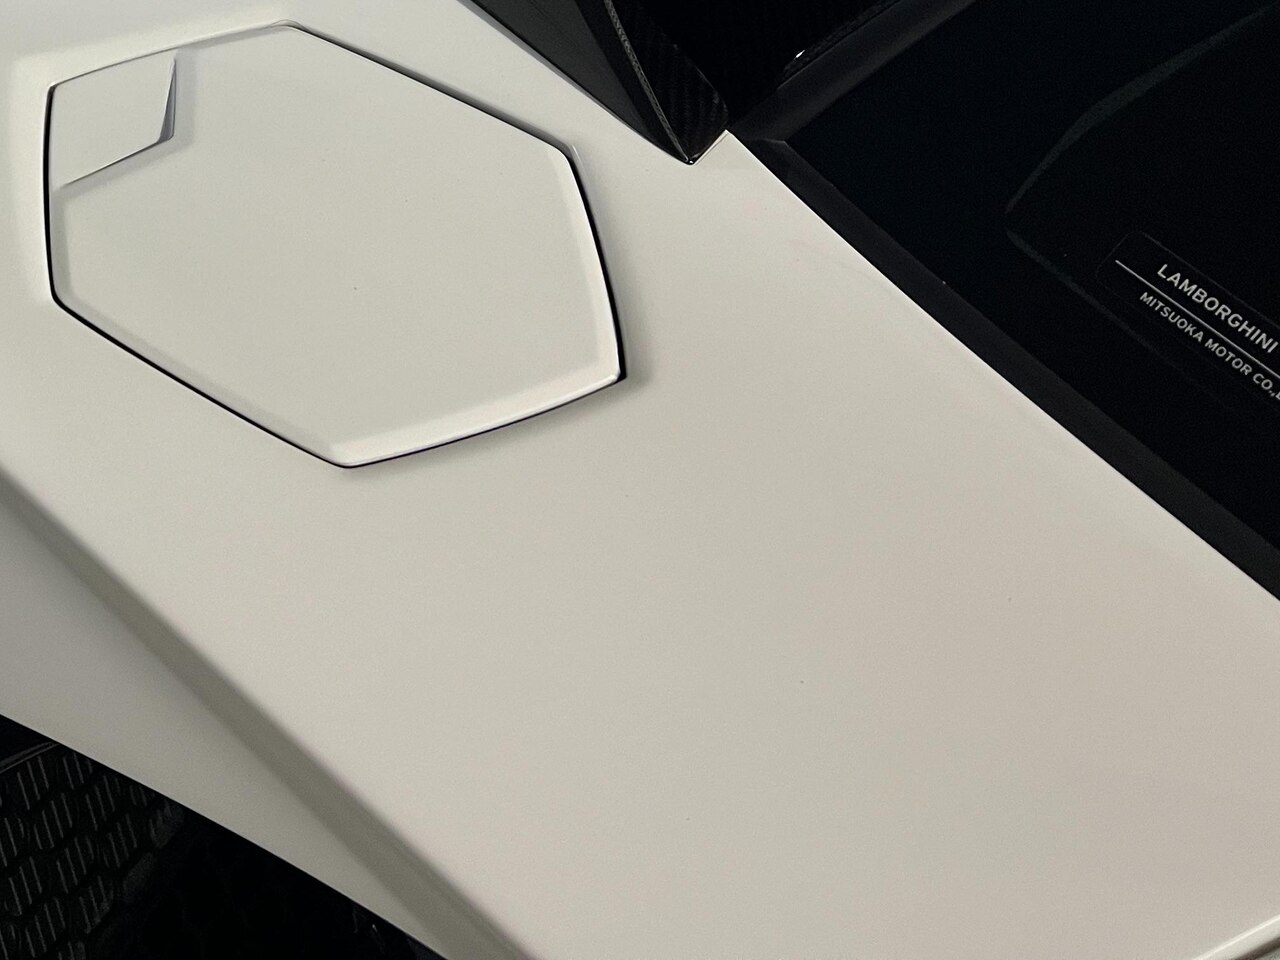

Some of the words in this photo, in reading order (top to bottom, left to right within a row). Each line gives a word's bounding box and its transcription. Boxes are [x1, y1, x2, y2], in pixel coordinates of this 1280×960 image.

[1140, 292, 1204, 341] MITSUOKA
[1205, 339, 1252, 375] MOTOR
[1157, 264, 1278, 353] LAMBORGHINI
